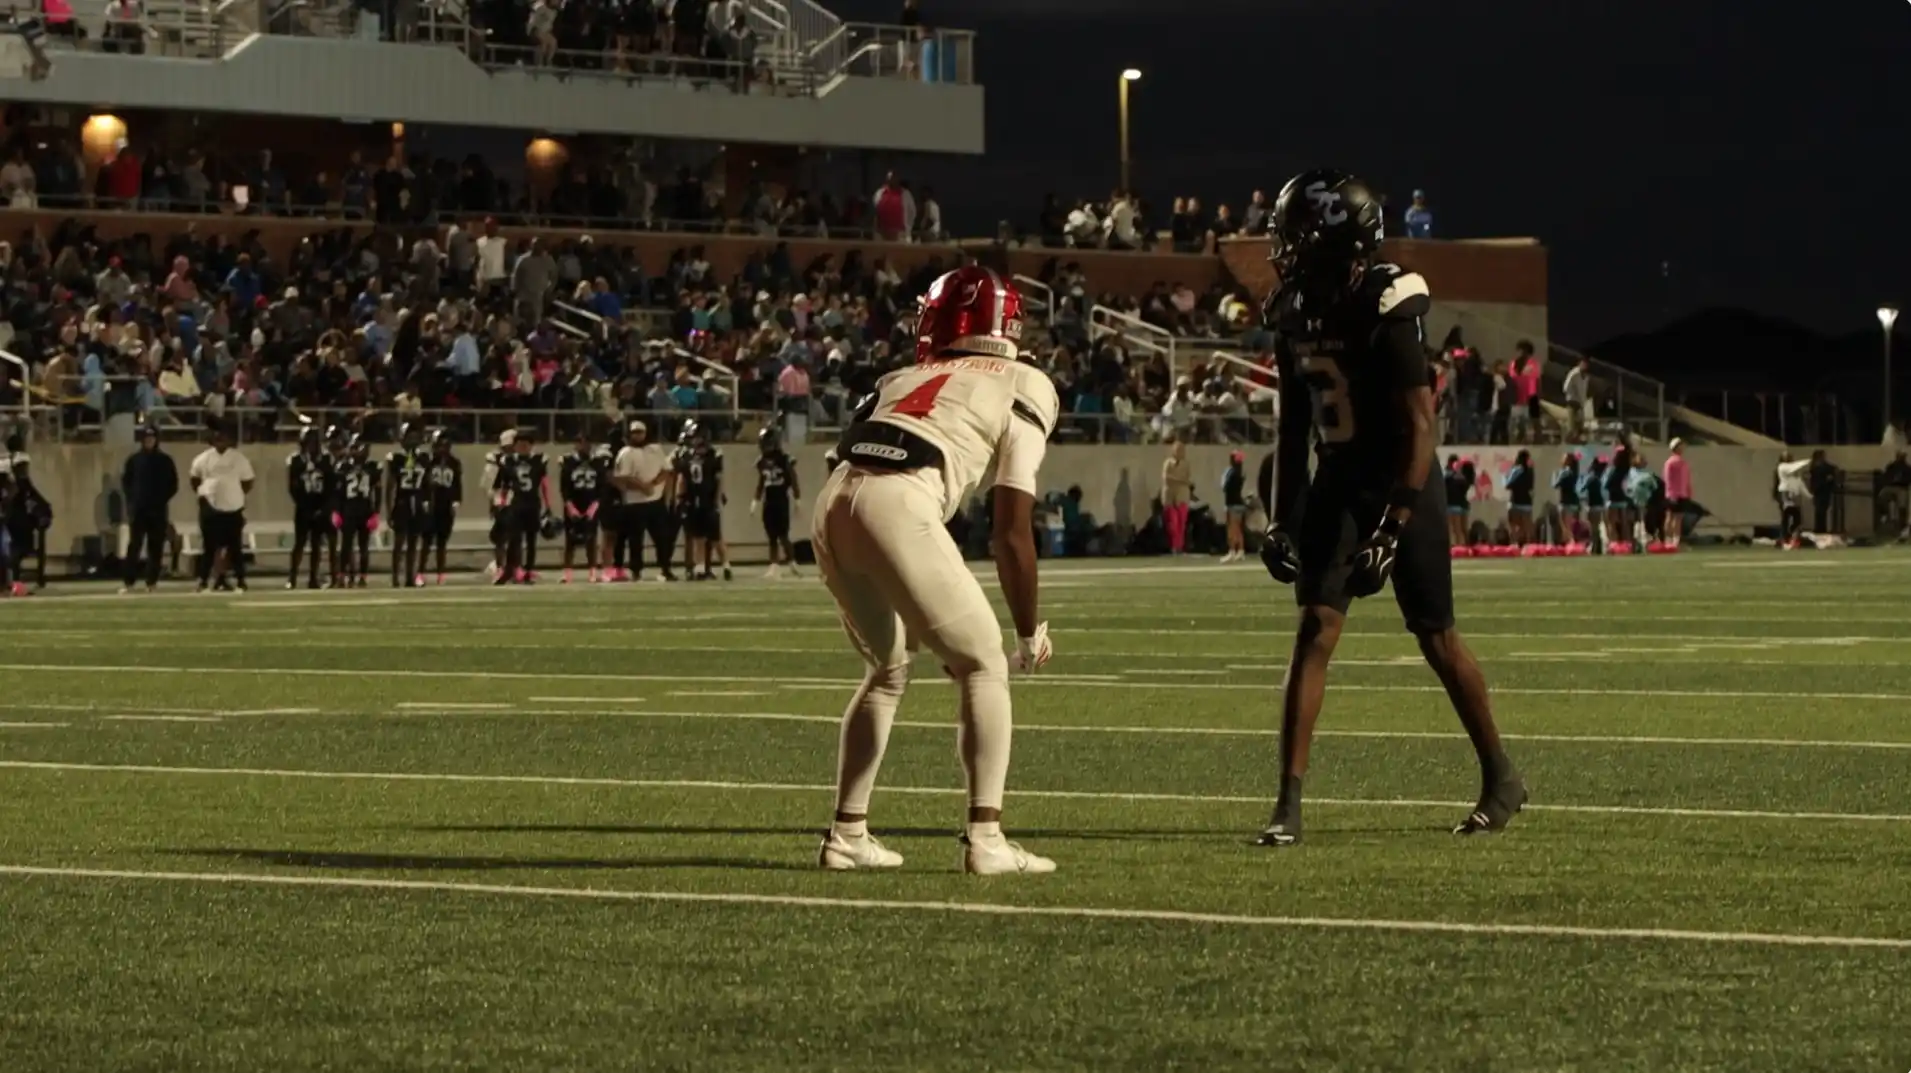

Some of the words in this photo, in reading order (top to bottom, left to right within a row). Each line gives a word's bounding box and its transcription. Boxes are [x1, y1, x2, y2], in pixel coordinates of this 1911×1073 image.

[1304, 180, 1348, 225] SC
[892, 374, 952, 420] 4
[345, 472, 370, 500] 24
[400, 467, 426, 489] 27
[516, 464, 533, 492] 5
[689, 463, 704, 485] 0
